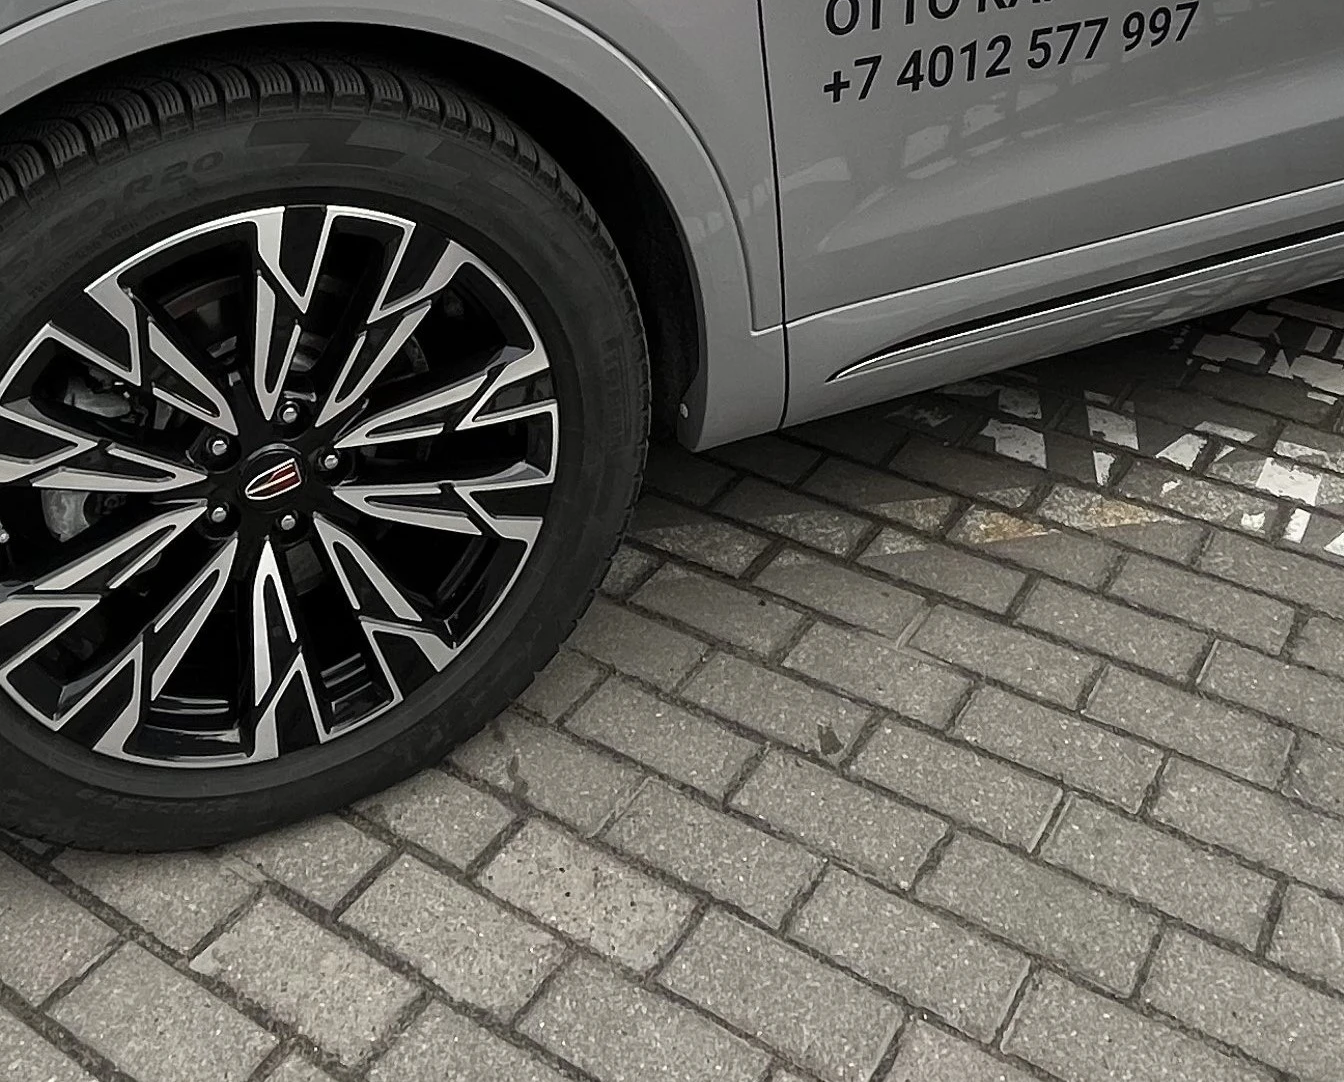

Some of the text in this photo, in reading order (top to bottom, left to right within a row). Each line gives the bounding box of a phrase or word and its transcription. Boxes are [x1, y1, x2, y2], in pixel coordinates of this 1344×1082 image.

[823, 0, 1201, 104] +7 4012 577 997
